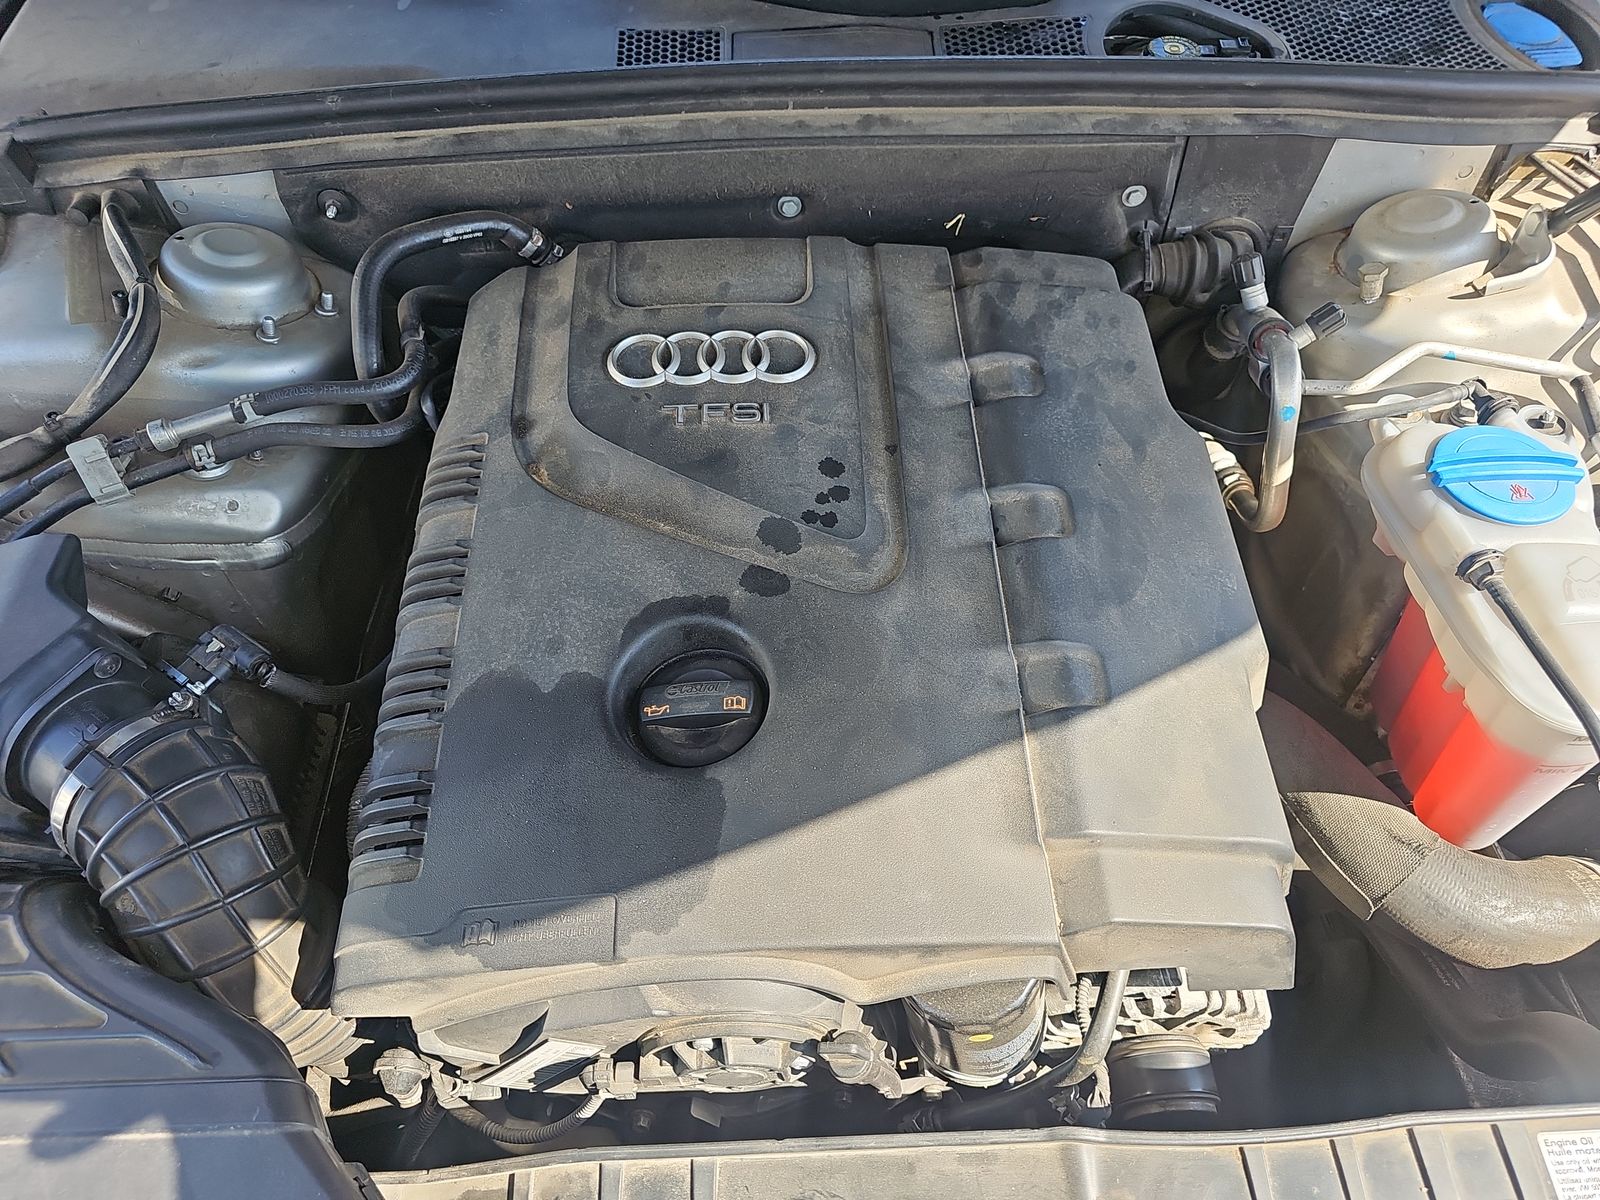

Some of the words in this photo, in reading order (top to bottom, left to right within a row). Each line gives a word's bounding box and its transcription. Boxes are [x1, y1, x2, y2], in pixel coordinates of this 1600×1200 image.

[660, 402, 770, 426] TFSI
[679, 682, 721, 695] Castrol
[1543, 1138, 1577, 1148] Engine
[1580, 1136, 1594, 1145] Oil
[1547, 1148, 1573, 1157] Huile
